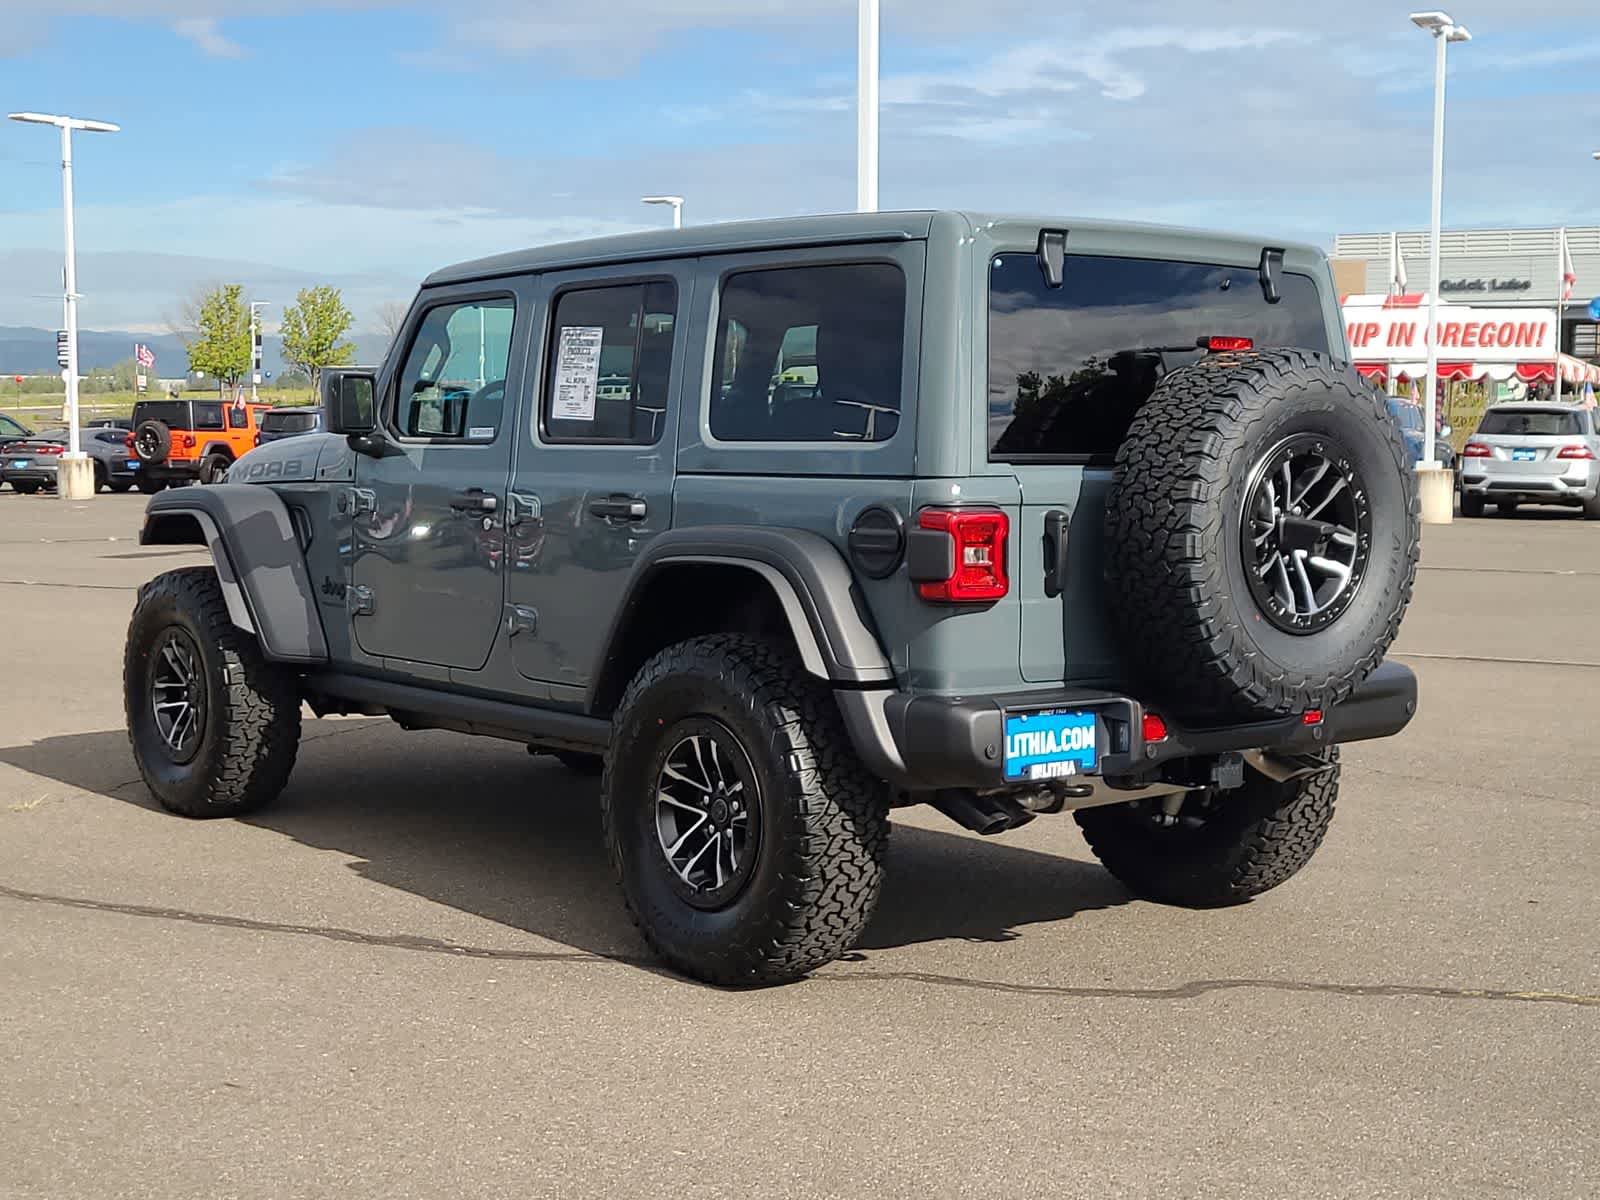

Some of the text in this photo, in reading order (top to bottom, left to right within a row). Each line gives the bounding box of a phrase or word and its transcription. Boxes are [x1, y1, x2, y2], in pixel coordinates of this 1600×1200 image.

[1386, 322, 1416, 348] IN
[1424, 321, 1548, 348] OREGON!
[1007, 725, 1095, 760] LITHIA.COM
